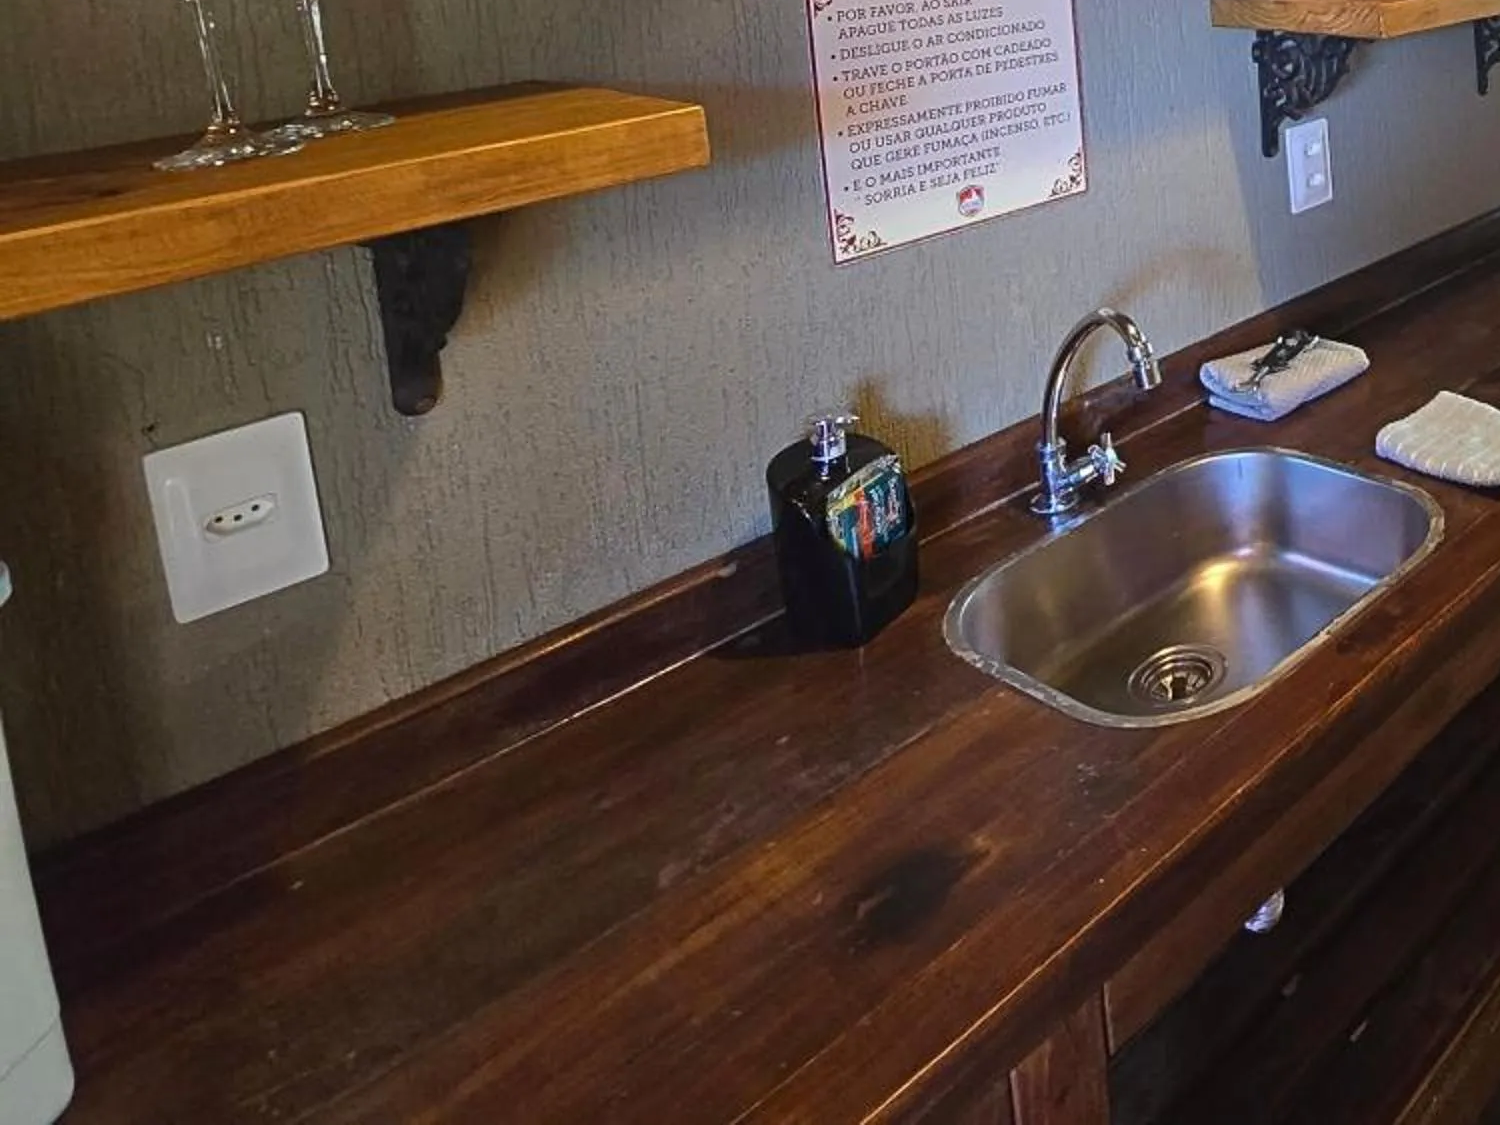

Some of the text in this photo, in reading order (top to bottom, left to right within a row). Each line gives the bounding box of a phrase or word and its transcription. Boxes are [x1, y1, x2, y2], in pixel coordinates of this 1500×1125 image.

[837, 8, 866, 23] POR
[838, 6, 1003, 40] APAGUE TODAS AS LUZES
[840, 19, 1045, 61] DESLIGUE O AR CONDICIONADO
[841, 37, 1052, 82] TRAVE O PORTÃO COM CADEADO
[843, 52, 1058, 99] OU FECHE A PORTA DE PEDESTRES
[847, 82, 1067, 137] EXPRESSAMENTE PROIBIDO FUMAR
[859, 94, 909, 114] CHAVE
[849, 102, 1047, 154] OU USAR QUALQUER PRODUTO
[851, 154, 882, 171] QUE
[885, 145, 920, 163] GERE
[923, 134, 978, 155] FUMAÇA
[853, 178, 862, 192] E
[865, 176, 877, 188] O
[880, 166, 914, 185] MAIS
[919, 180, 927, 192] E
[930, 171, 960, 187] SEJA
